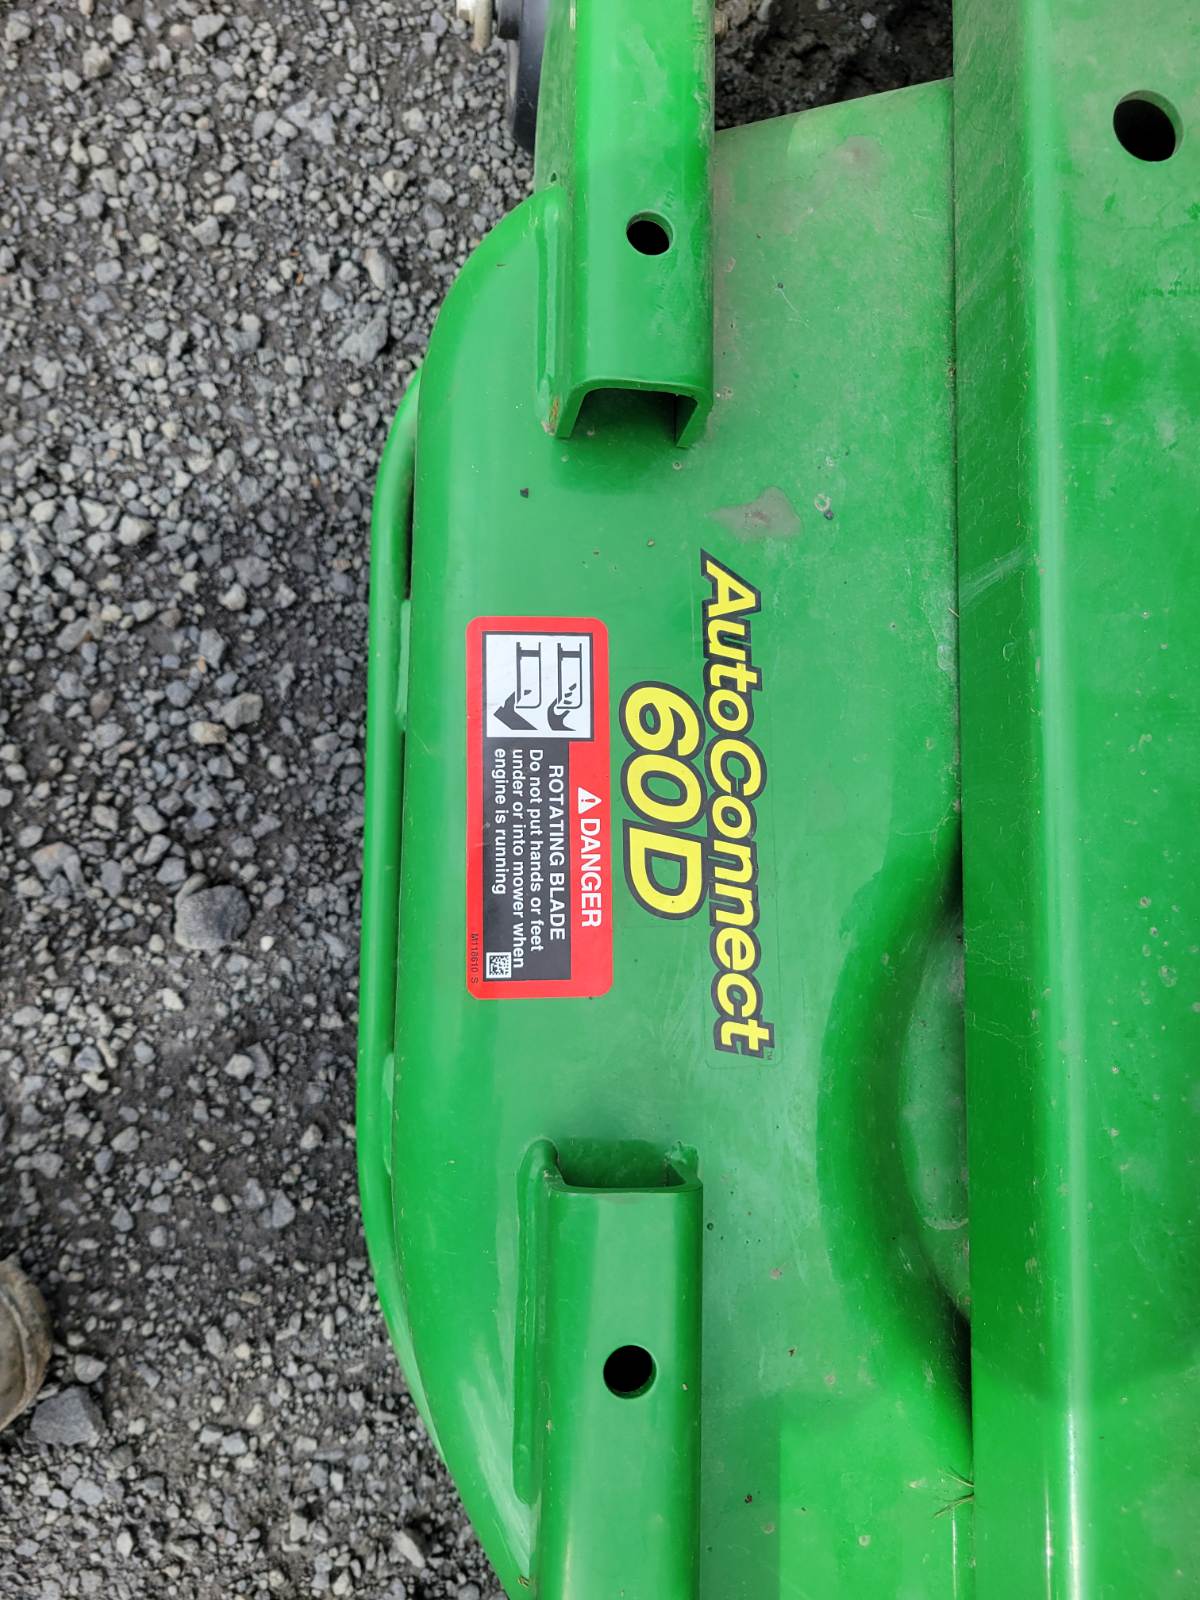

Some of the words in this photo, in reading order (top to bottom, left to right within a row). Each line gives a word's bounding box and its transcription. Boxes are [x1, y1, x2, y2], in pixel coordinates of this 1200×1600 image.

[491, 748, 509, 805] engine
[512, 749, 526, 797] under
[529, 749, 543, 772] Do
[512, 801, 523, 819] or
[529, 777, 542, 804] not
[621, 683, 708, 919] 60D
[702, 550, 771, 1057] AutoConnect
[495, 810, 509, 824] is
[512, 824, 526, 856] into
[527, 808, 543, 836] put
[548, 765, 565, 868] ROTATING
[491, 829, 509, 894] running
[530, 841, 544, 892] hands
[580, 818, 602, 927] DANGER
[512, 861, 524, 918] mower
[530, 897, 542, 915] or
[549, 873, 566, 940] BLADE
[512, 922, 527, 968] when
[530, 919, 544, 952] feet
